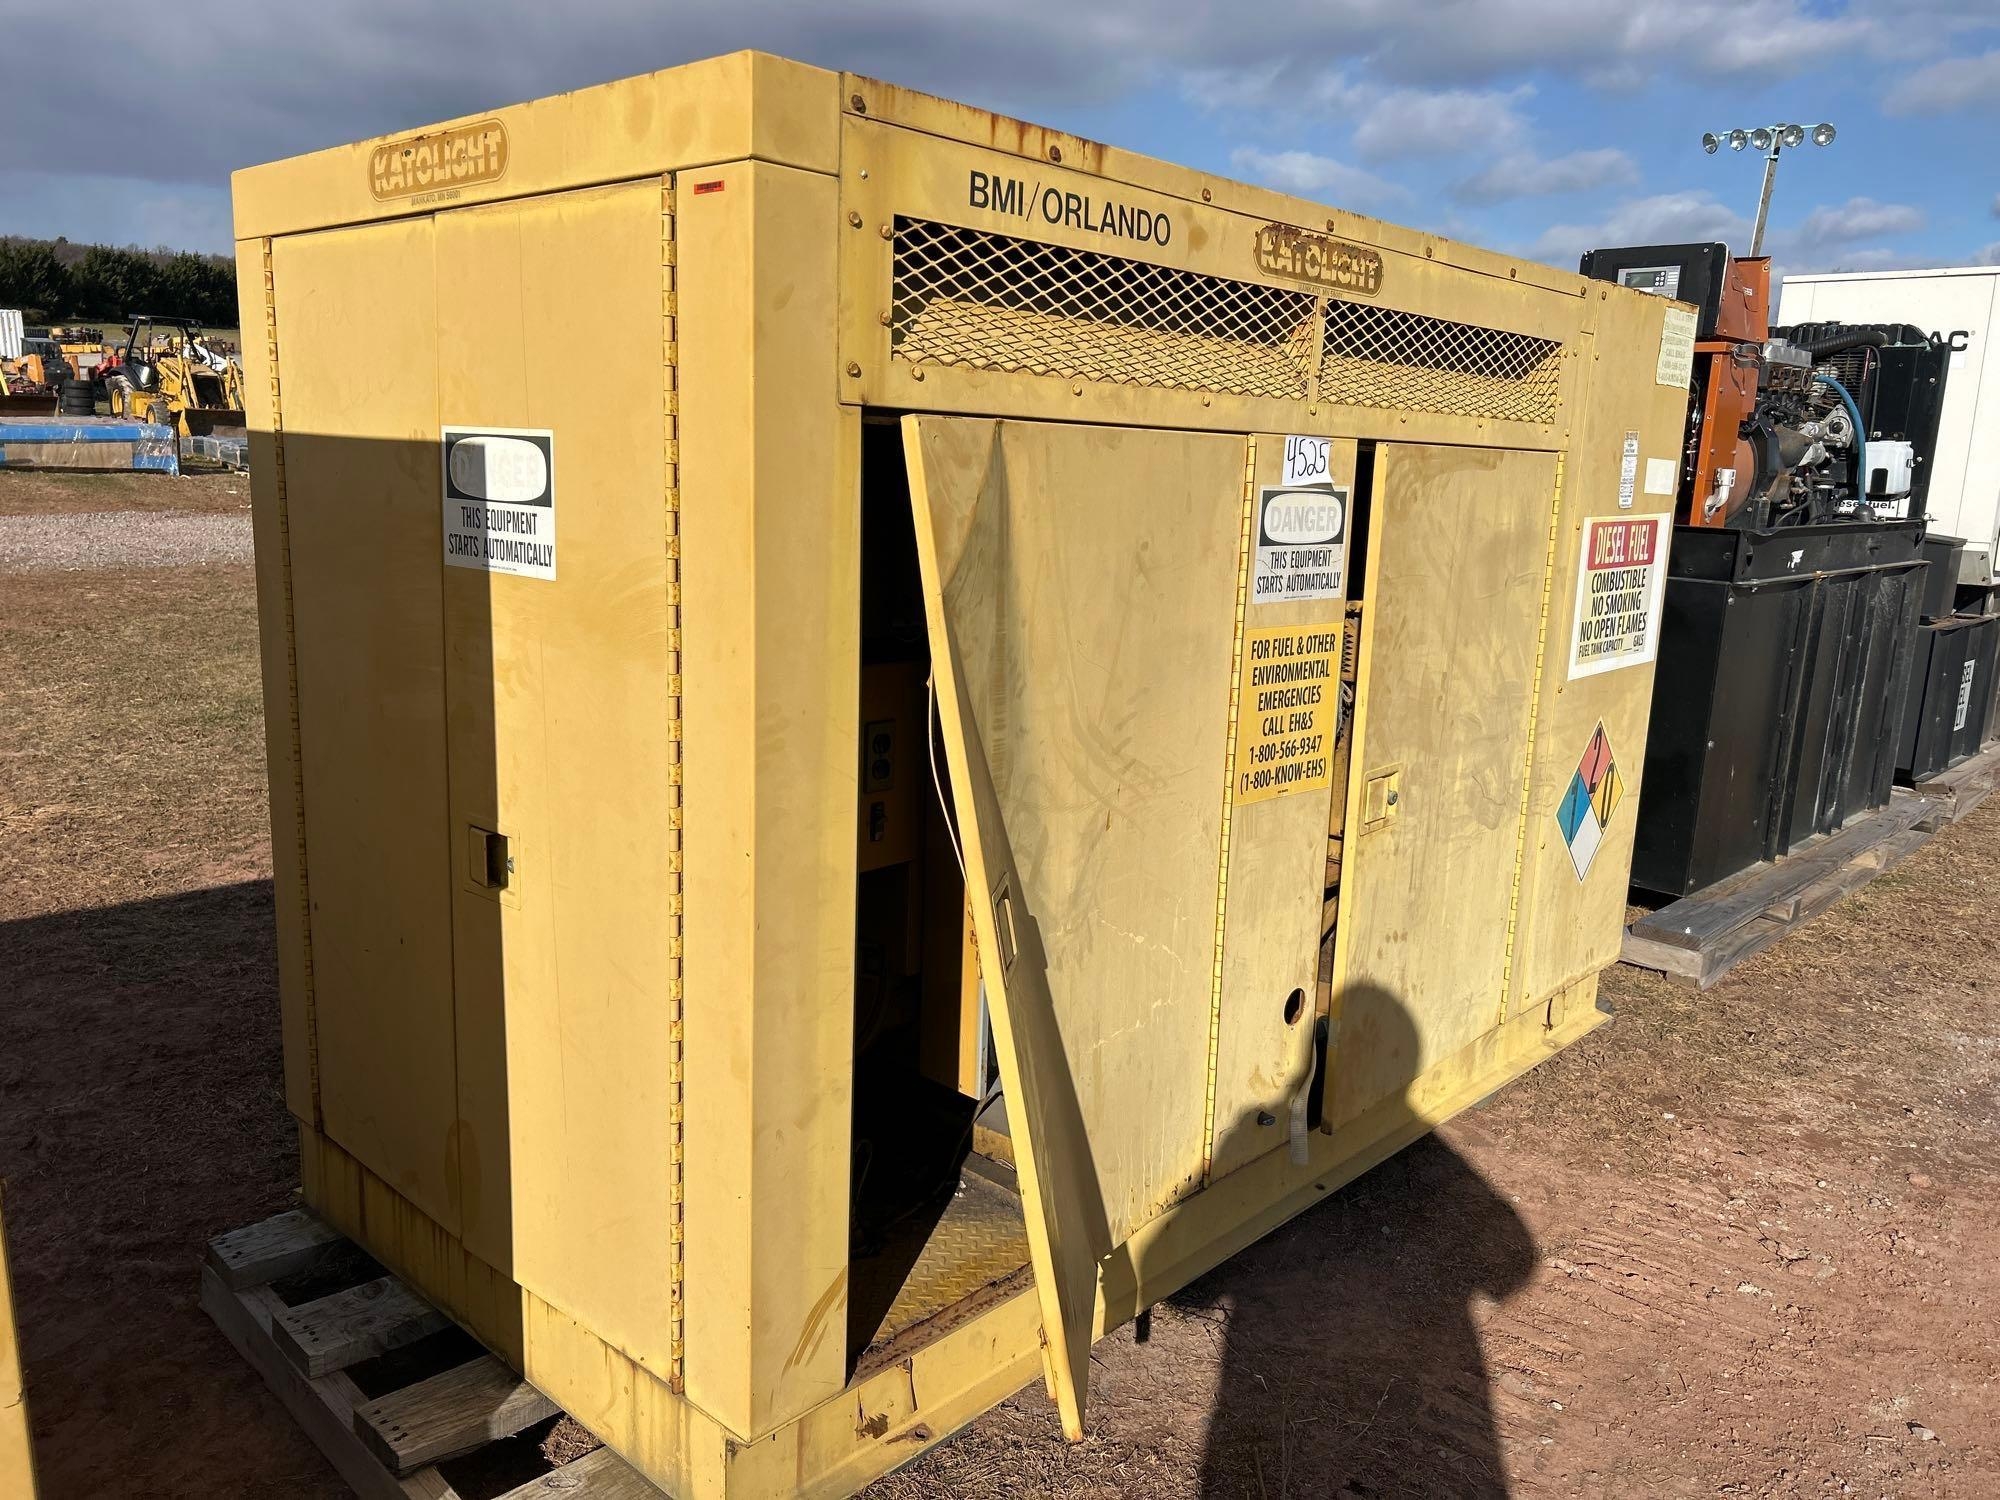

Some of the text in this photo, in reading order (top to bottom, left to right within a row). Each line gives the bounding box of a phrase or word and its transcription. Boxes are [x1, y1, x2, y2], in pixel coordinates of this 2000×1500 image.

[374, 130, 502, 193] KATOLIGHT
[969, 169, 1171, 247] BMI/ORLANDO
[1260, 231, 1379, 289] KATOLIGHT
[1287, 437, 1330, 479] 4525
[461, 506, 538, 536] THIS EQUIPMENT
[1270, 506, 1338, 533] DANGER
[449, 533, 553, 568] STARTS AUTOMATICALLY
[1594, 524, 1650, 565] DIESEL FUEL
[1270, 549, 1333, 570] THIS EQUIPMENT
[1256, 571, 1342, 595] STARTS AUTOMATICALLY
[1591, 568, 1647, 594] COMBUSTIBLE
[1591, 591, 1642, 618] NO SMOKING
[1580, 612, 1647, 643] NO OPEN FLAMES
[1250, 633, 1336, 661] FOR FUEL & OTHER
[1602, 637, 1624, 653] CAPACITY
[1252, 659, 1330, 687] ENVIRONMENTAL
[1257, 685, 1322, 712] EMERGENCIES
[1262, 711, 1314, 737] CALL EH&S
[1250, 734, 1323, 765] 1-800-566-9347
[1240, 757, 1327, 795] (1-800-KNOW-EHS)
